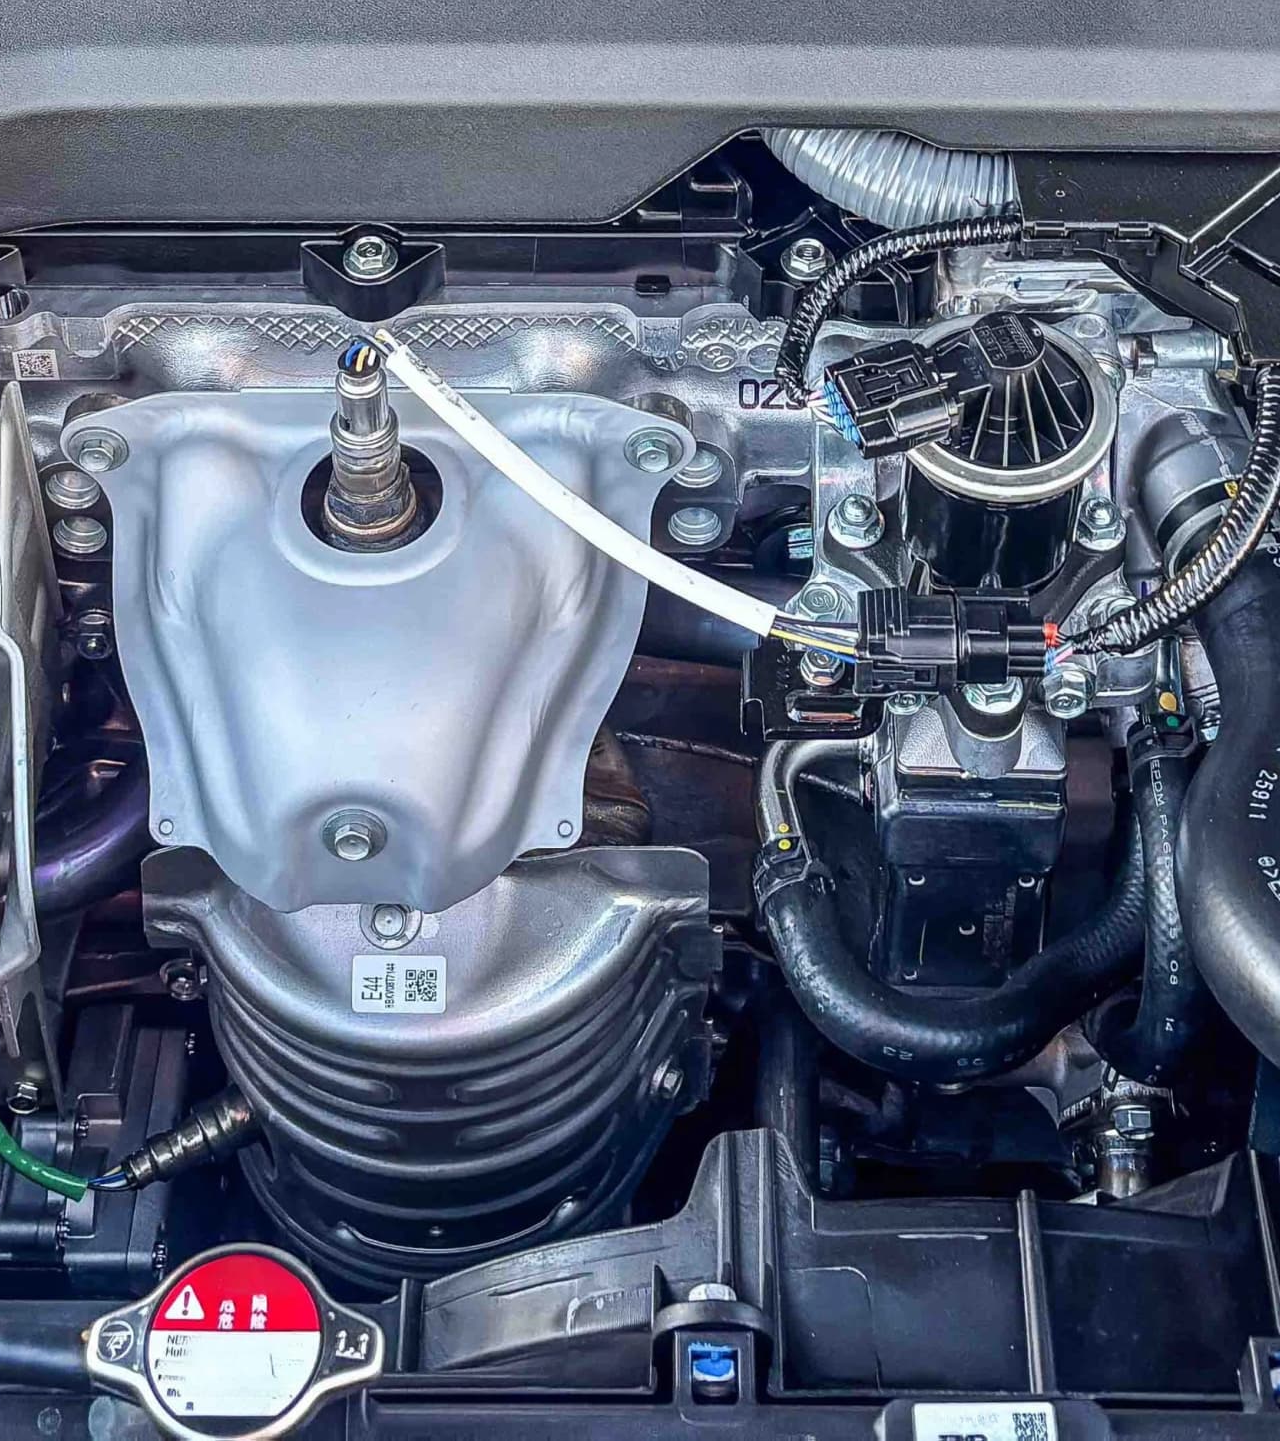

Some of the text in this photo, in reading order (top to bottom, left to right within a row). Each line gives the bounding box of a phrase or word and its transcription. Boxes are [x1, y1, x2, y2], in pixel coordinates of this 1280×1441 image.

[738, 379, 806, 410] 02
[1248, 768, 1279, 822] 25911
[361, 976, 383, 1000] E44
